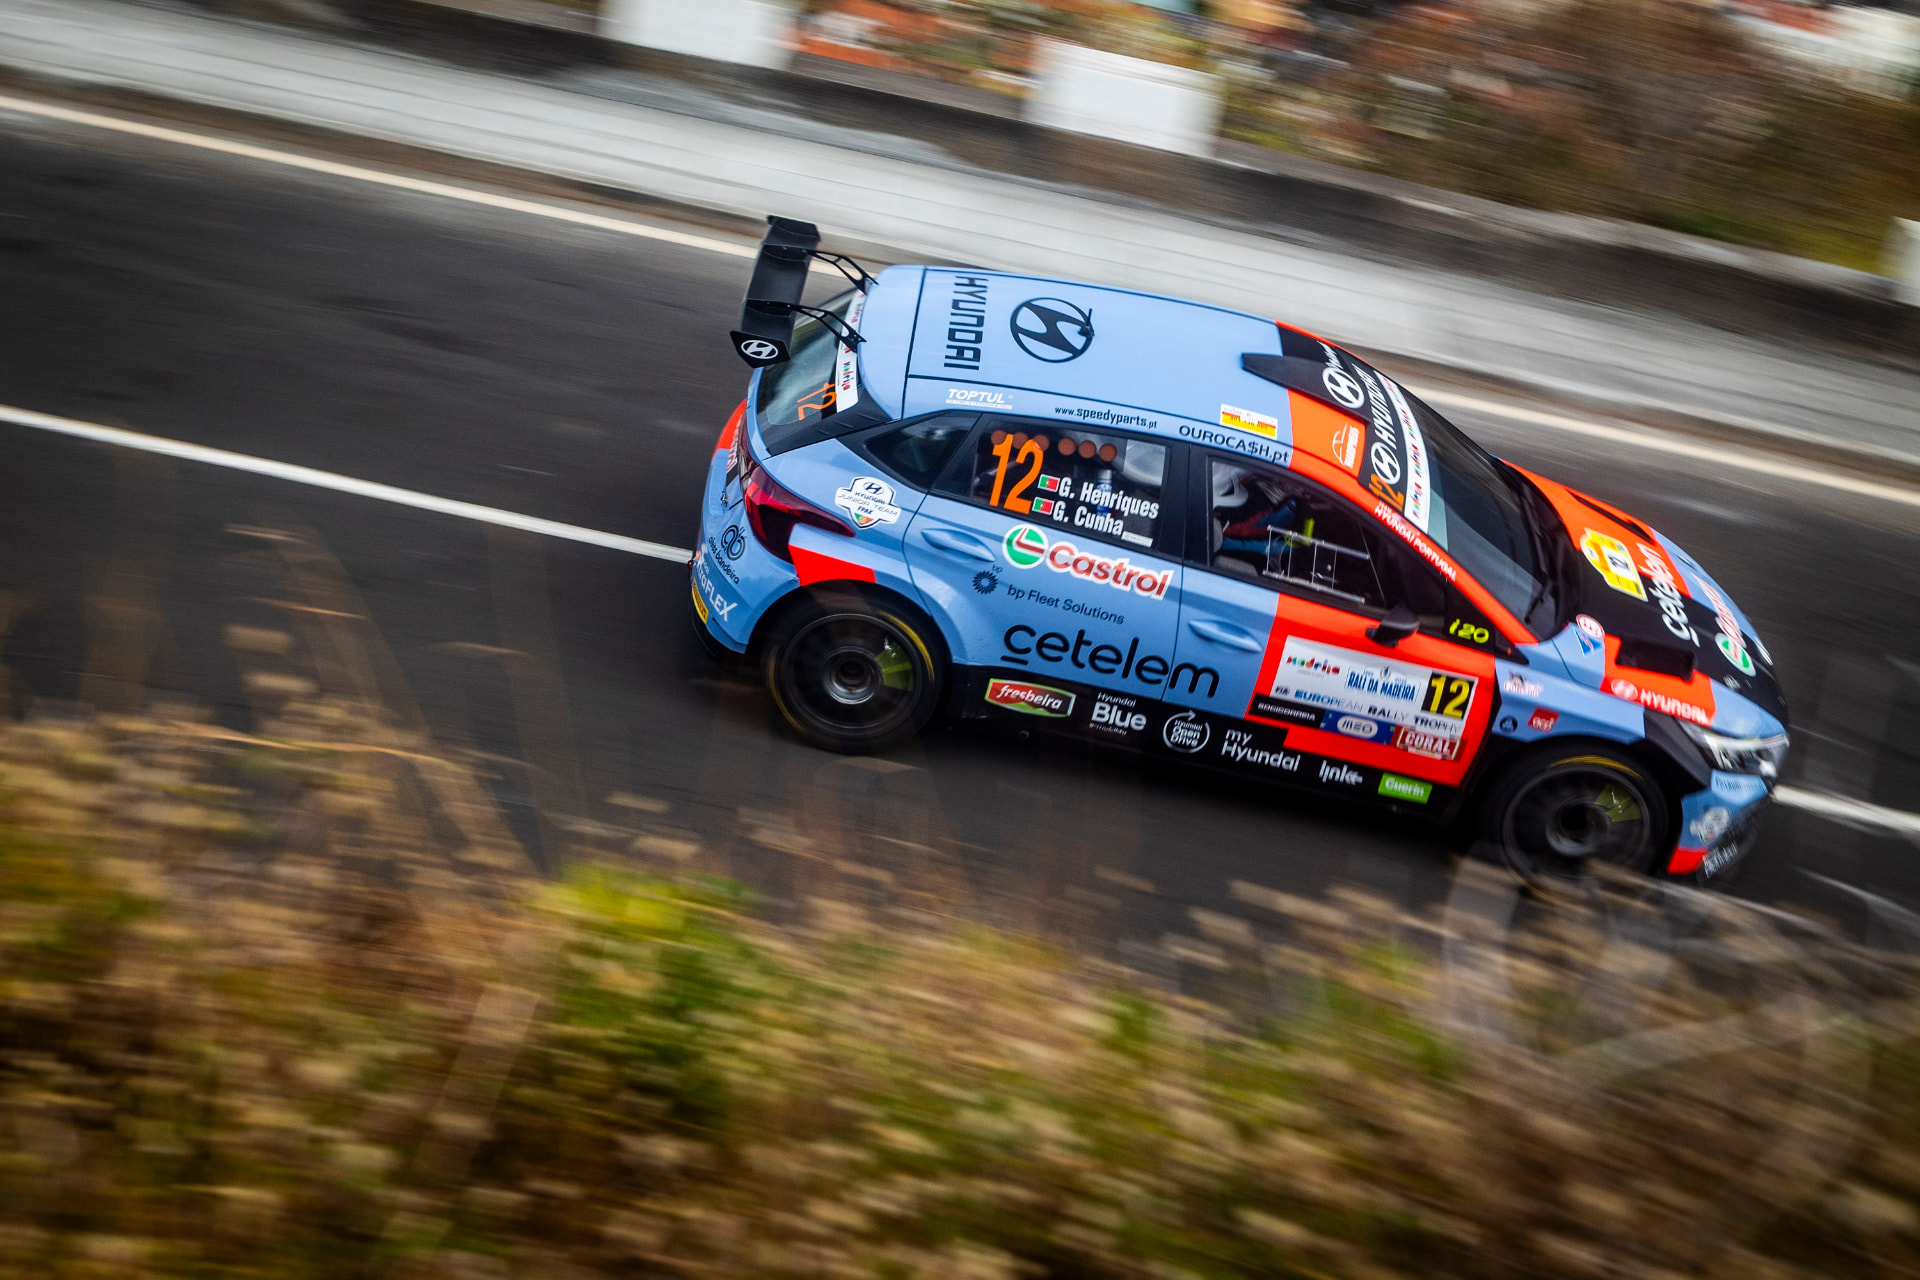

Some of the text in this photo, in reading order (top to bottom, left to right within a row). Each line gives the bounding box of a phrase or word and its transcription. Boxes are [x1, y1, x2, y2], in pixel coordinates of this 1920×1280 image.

[943, 275, 988, 371] HYUNDAI
[796, 382, 837, 421] 12
[948, 388, 1006, 405] TOPTUL
[1352, 364, 1397, 450] HYUNDAI
[1054, 406, 1158, 429] www.speedyparts.pt
[1178, 425, 1290, 463] OUROCA$H.pt
[989, 434, 1044, 515] 12
[1369, 473, 1405, 511] 12
[1058, 476, 1159, 519] G. Henriques
[1052, 500, 1124, 536] G. Cunha
[714, 554, 740, 584] bandeira
[1048, 545, 1171, 597] Castrol
[1007, 584, 1124, 624] bp Fleet Solutions
[1000, 624, 1220, 698] cetelem
[996, 684, 1063, 711] fresbeira
[1097, 692, 1136, 708] Hyundai
[1347, 671, 1367, 688] RALI
[1367, 677, 1379, 691] DA
[1380, 680, 1416, 701] MADEIRA
[1429, 675, 1469, 719] 12
[1091, 702, 1147, 731] Blue
[1294, 690, 1363, 712] EUROPEAN
[1367, 705, 1410, 722] RALLY
[1413, 714, 1462, 734] TROPHY
[1640, 688, 1709, 724] HYUNDAI
[1170, 733, 1198, 748] Drive
[1172, 726, 1201, 741] Open
[1225, 729, 1252, 746] my
[1405, 731, 1451, 754] CORAL
[1221, 741, 1301, 772] Hyundai
[1385, 777, 1426, 798] Guerin
